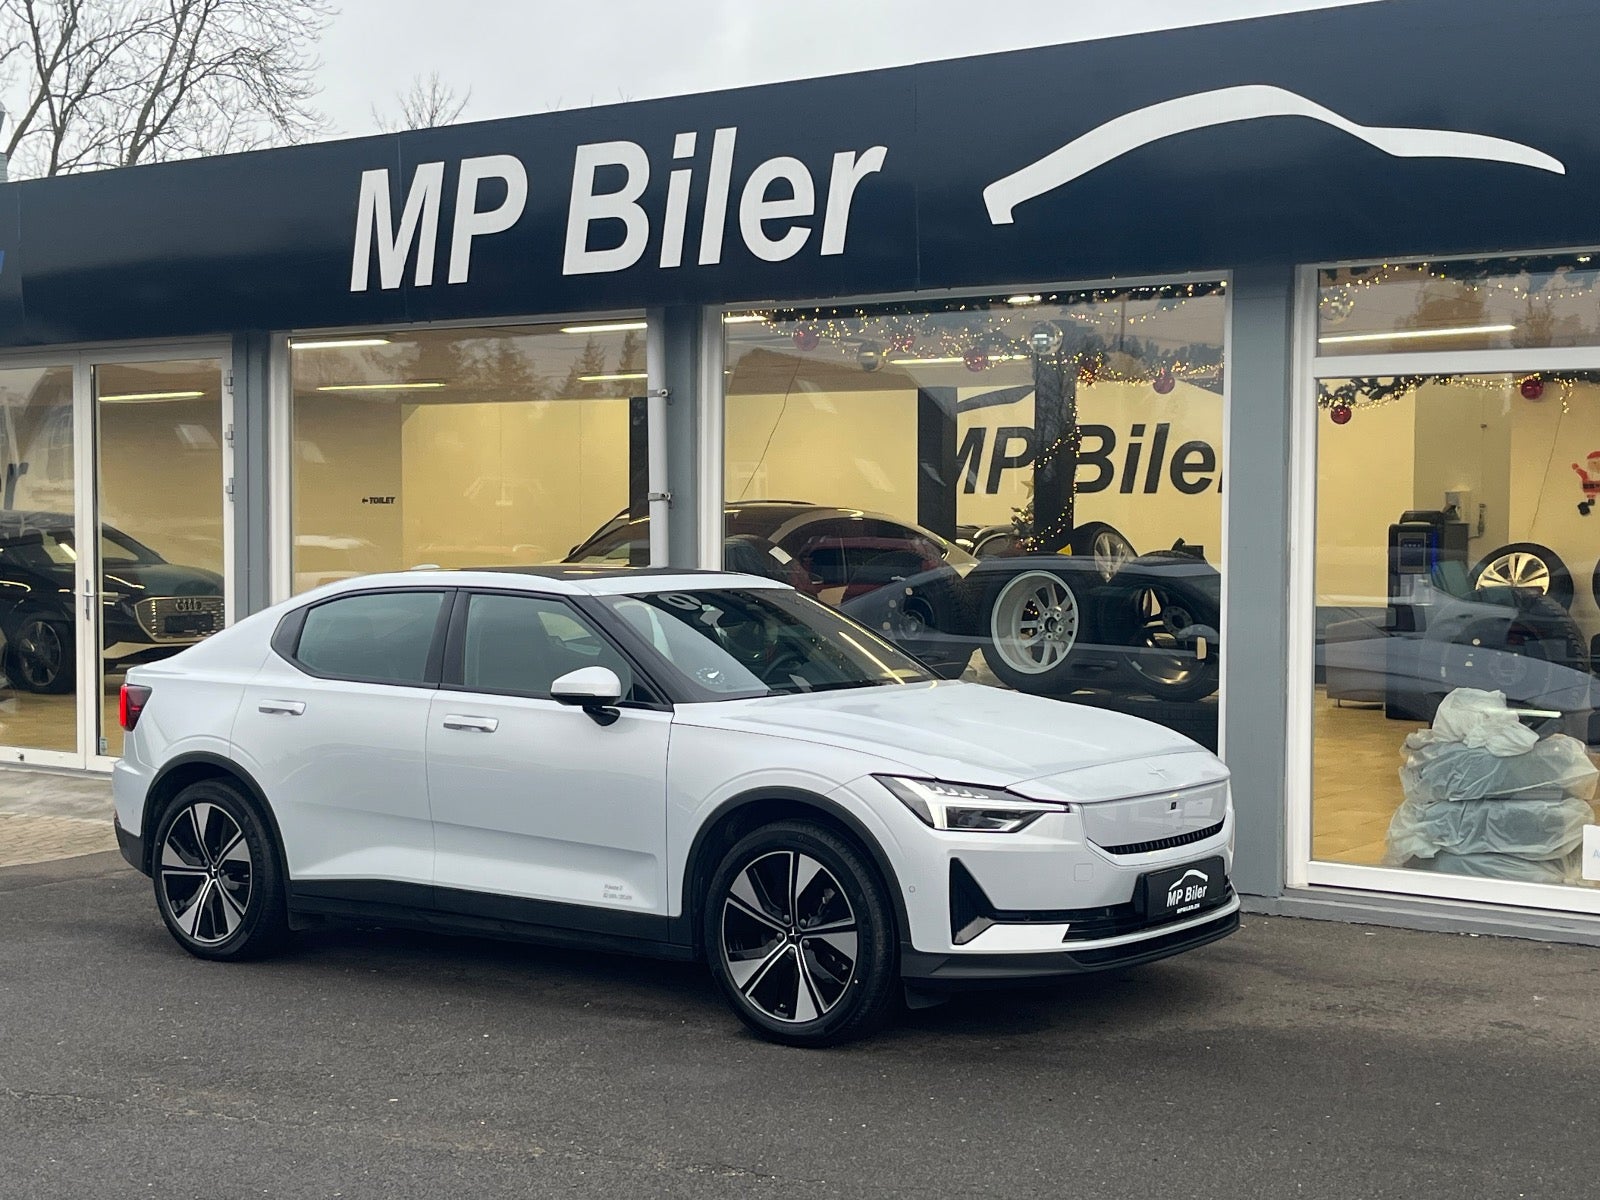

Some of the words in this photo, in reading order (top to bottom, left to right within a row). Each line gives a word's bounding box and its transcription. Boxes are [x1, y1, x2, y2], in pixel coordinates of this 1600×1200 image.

[350, 154, 528, 291] MP
[563, 127, 888, 275] Biler
[1073, 423, 1222, 494] Bile
[369, 496, 396, 504] TOILET
[1166, 889, 1183, 907] MP
[1184, 885, 1208, 902] Biler
